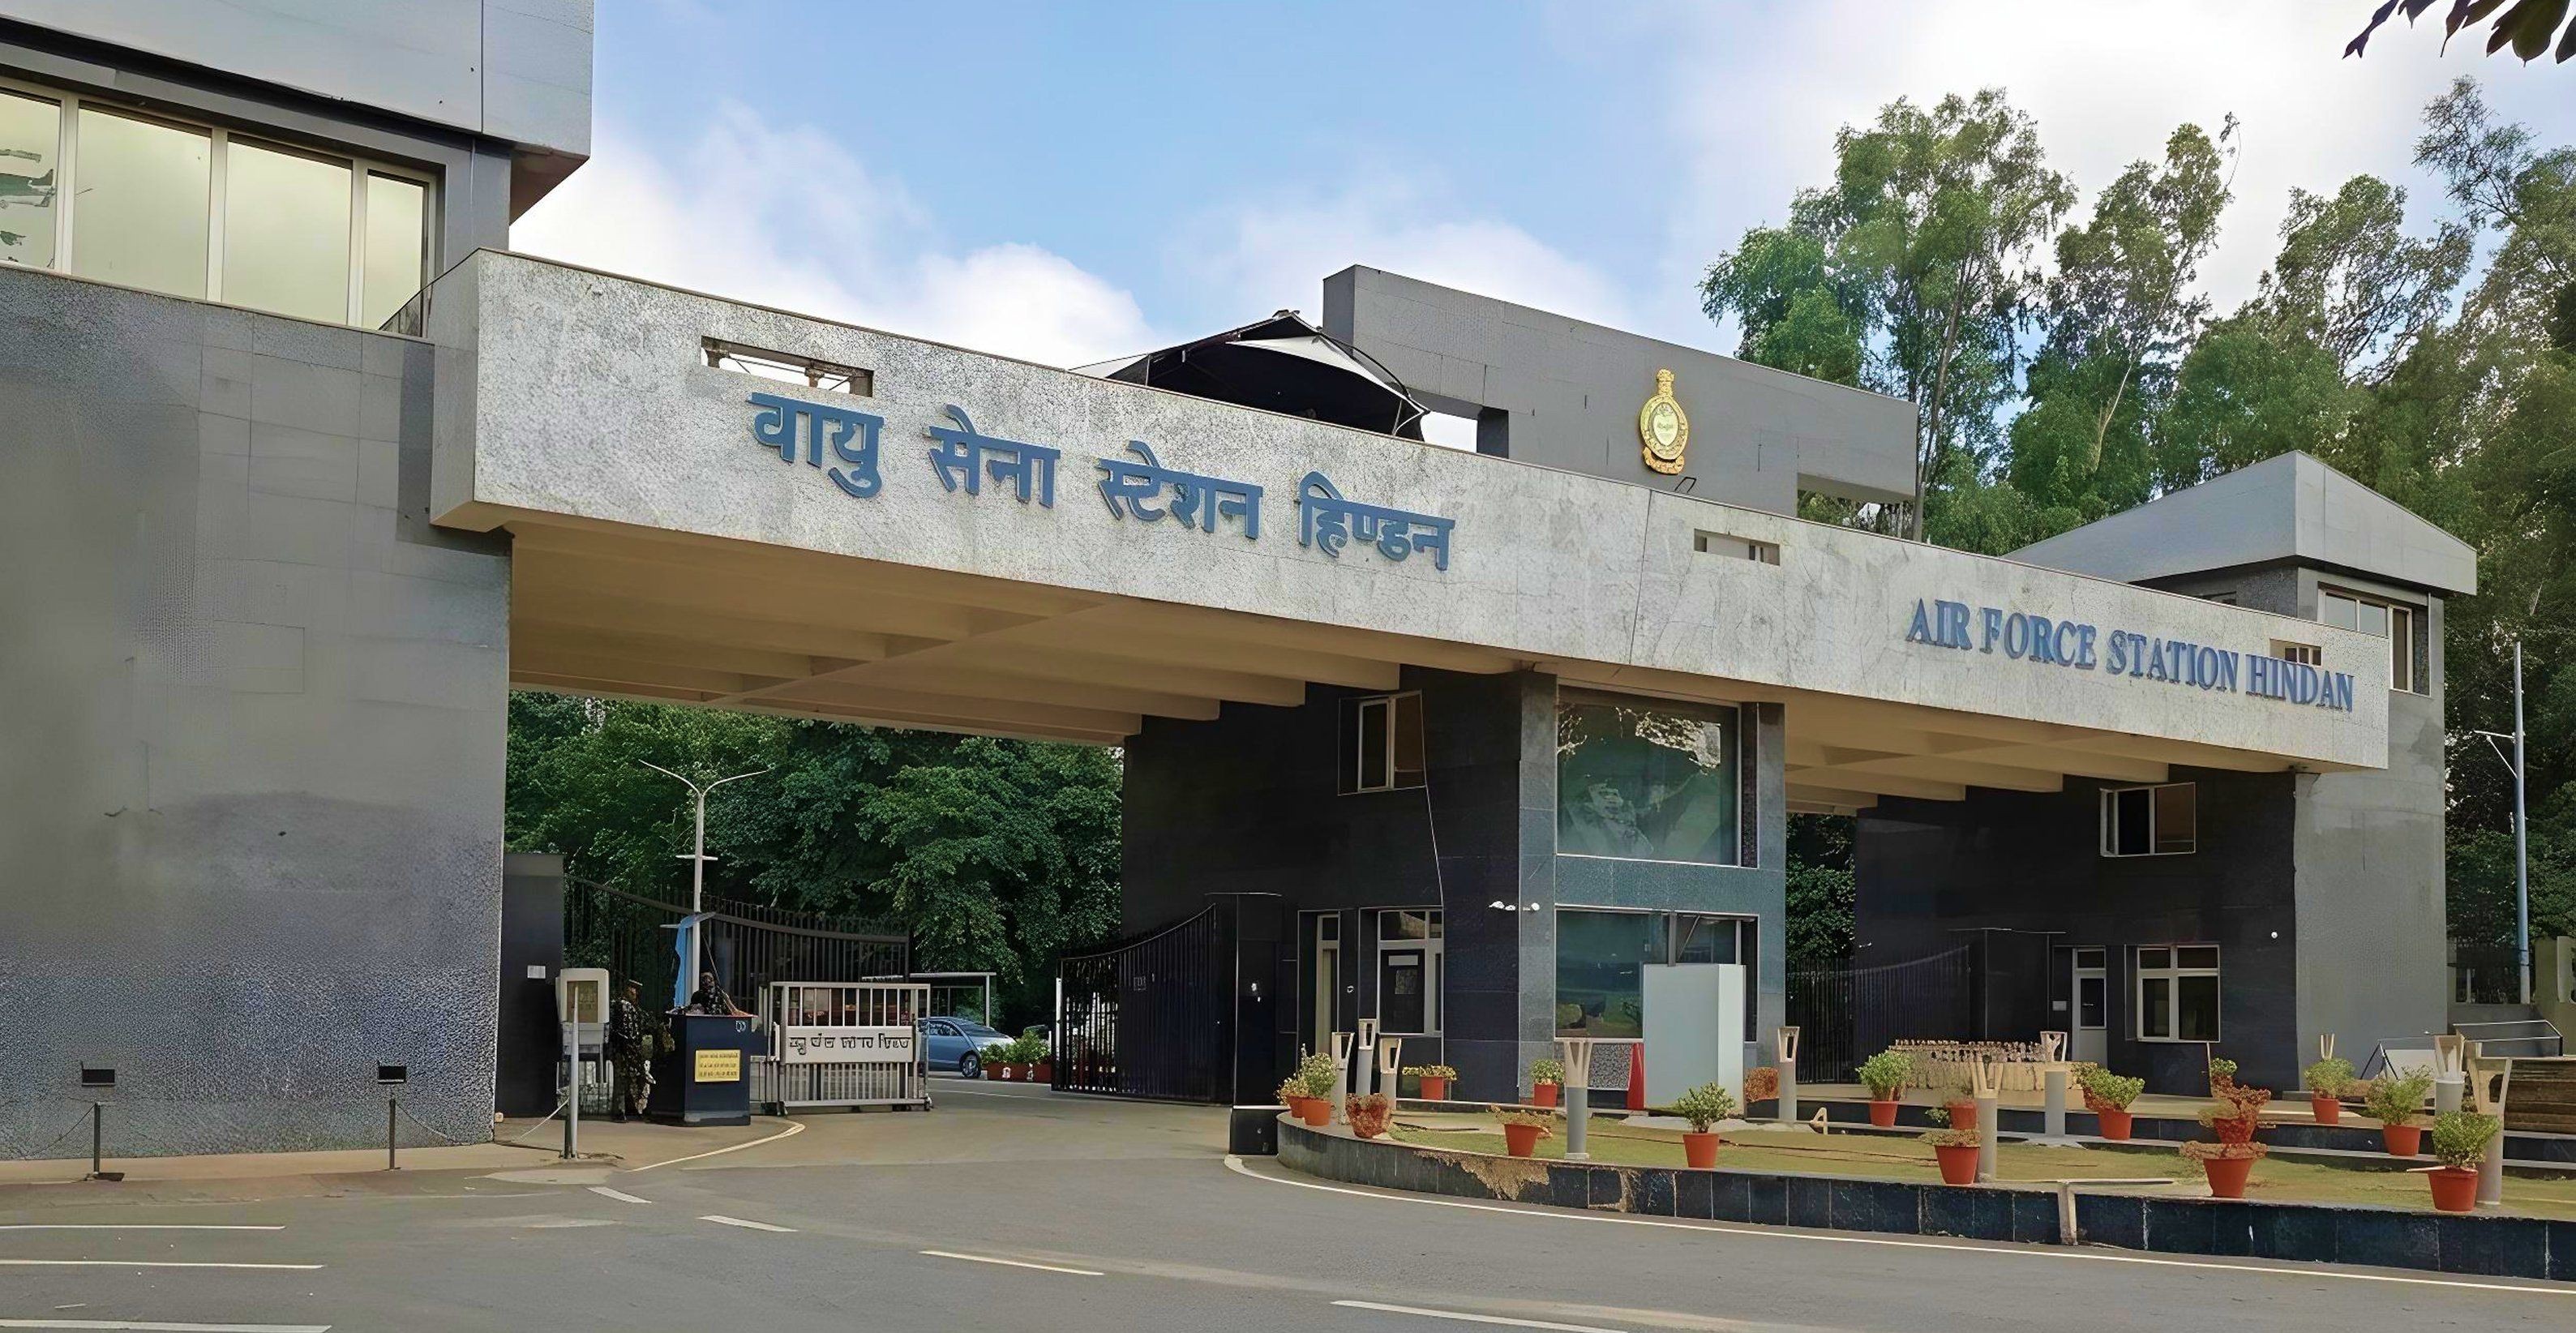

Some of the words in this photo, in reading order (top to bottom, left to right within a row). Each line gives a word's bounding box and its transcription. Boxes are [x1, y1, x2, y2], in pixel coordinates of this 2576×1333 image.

[748, 392, 885, 498] वायु
[928, 404, 1061, 508] सेना
[1097, 439, 1263, 538] स्टेशन
[1298, 471, 1455, 571] हिण्डन
[1905, 598, 1973, 651] AIR
[1979, 606, 2098, 671] FORCE
[2107, 630, 2239, 693] STATION
[2245, 654, 2354, 713] HINDAN
